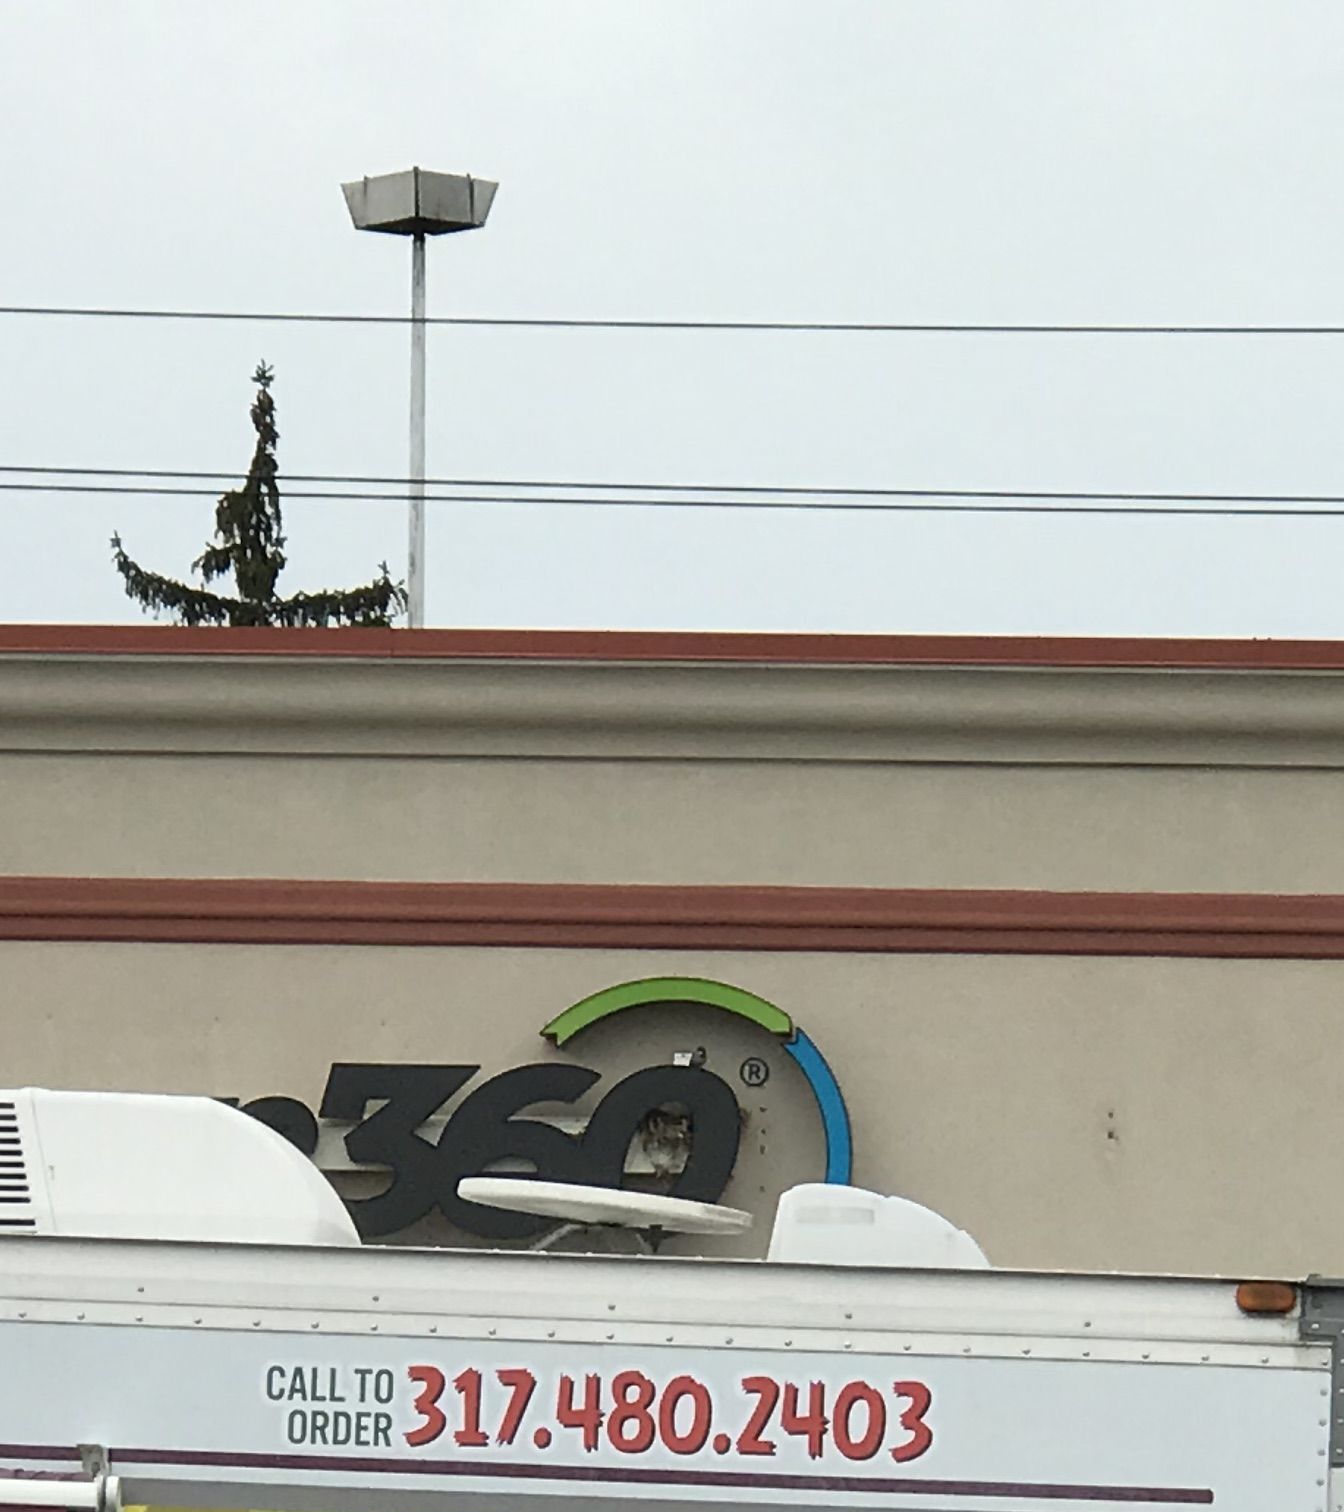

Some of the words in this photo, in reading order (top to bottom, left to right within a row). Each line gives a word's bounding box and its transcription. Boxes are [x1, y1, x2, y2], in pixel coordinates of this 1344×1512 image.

[266, 1366, 346, 1403] CALL
[354, 1370, 394, 1404] TO
[405, 1367, 933, 1460] 317.480.2403
[288, 1409, 393, 1447] ORDER
